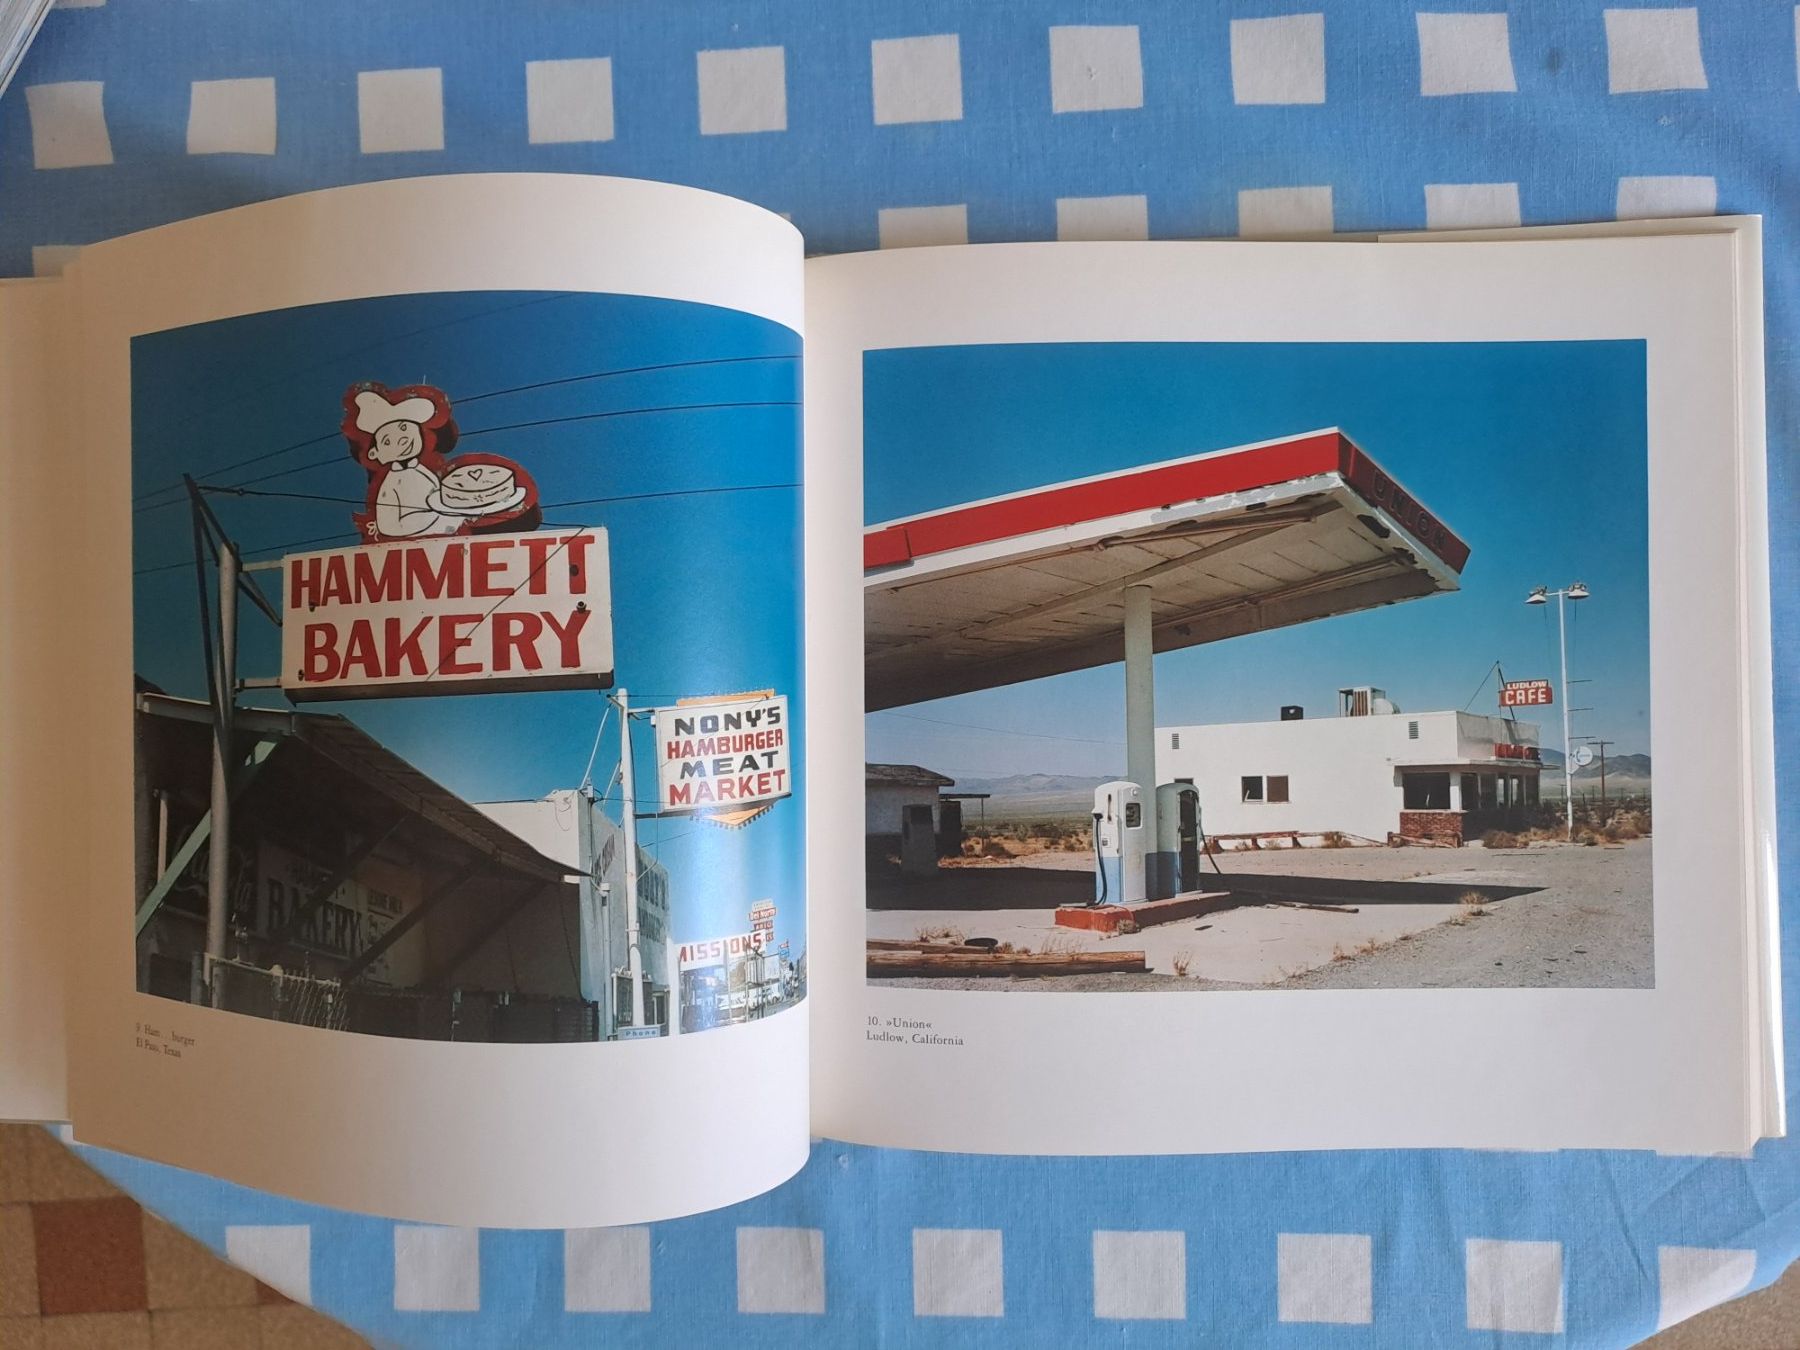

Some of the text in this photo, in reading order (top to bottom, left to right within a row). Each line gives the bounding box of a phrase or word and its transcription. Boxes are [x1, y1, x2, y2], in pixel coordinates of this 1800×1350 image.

[291, 535, 595, 608] HAMMETT
[304, 610, 591, 682] BAKERY
[1505, 689, 1546, 705] CAFE
[1507, 681, 1547, 690] LUDLOW
[674, 706, 781, 736] NONY'S
[667, 728, 783, 760] HAMBURGER
[680, 751, 779, 780] MEAT
[669, 769, 786, 806] MARKET
[867, 1015, 882, 1026] 10.
[866, 1030, 964, 1046] Ludlow, California
